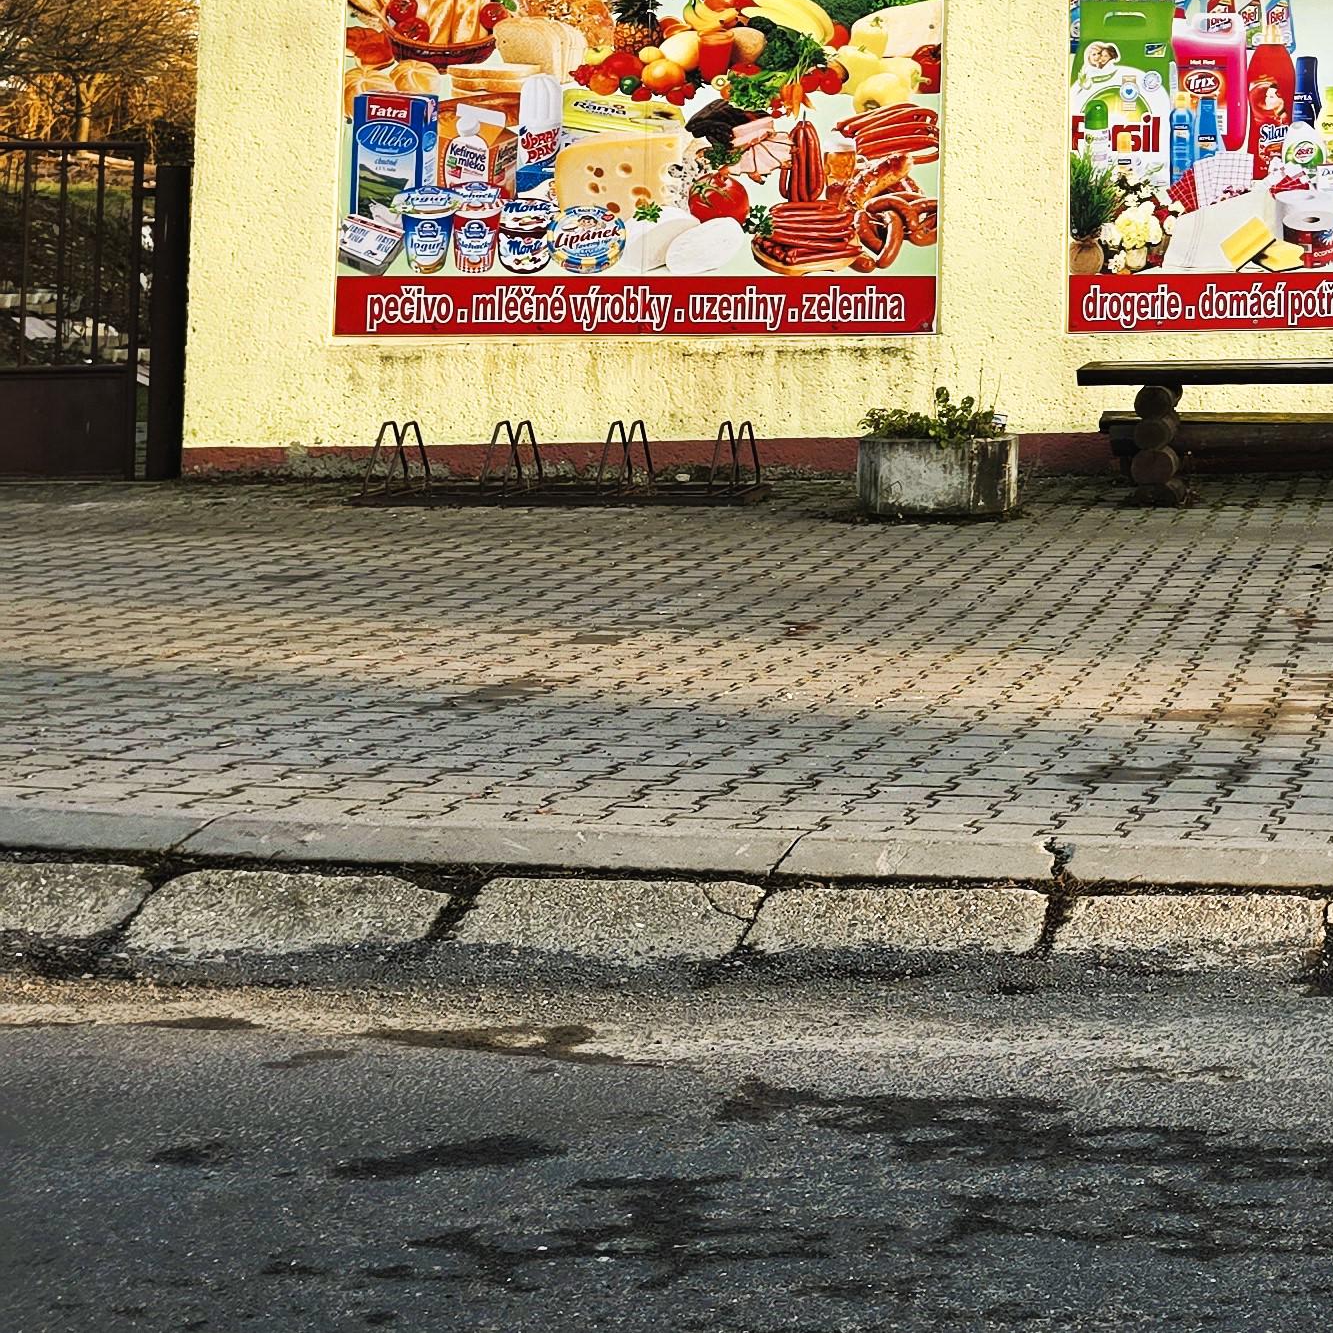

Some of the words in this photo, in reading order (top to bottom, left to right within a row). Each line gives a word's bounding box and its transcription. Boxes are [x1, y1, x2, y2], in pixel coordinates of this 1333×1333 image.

[1187, 75, 1217, 91] Trix
[369, 104, 408, 119] Tatra
[573, 98, 627, 116] Rama
[364, 125, 414, 149] Mléko
[449, 142, 487, 164] Kefírové
[458, 156, 486, 173] mléko
[503, 201, 551, 215] Monte
[554, 225, 622, 250] Lipánek
[366, 285, 454, 332] pečivo
[472, 285, 566, 323] mléčné
[569, 285, 672, 332] výrobky
[689, 285, 787, 331] uzeniny
[801, 285, 906, 323] zelenina
[1083, 283, 1183, 328] drogerie
[1199, 282, 1286, 319] domácí
